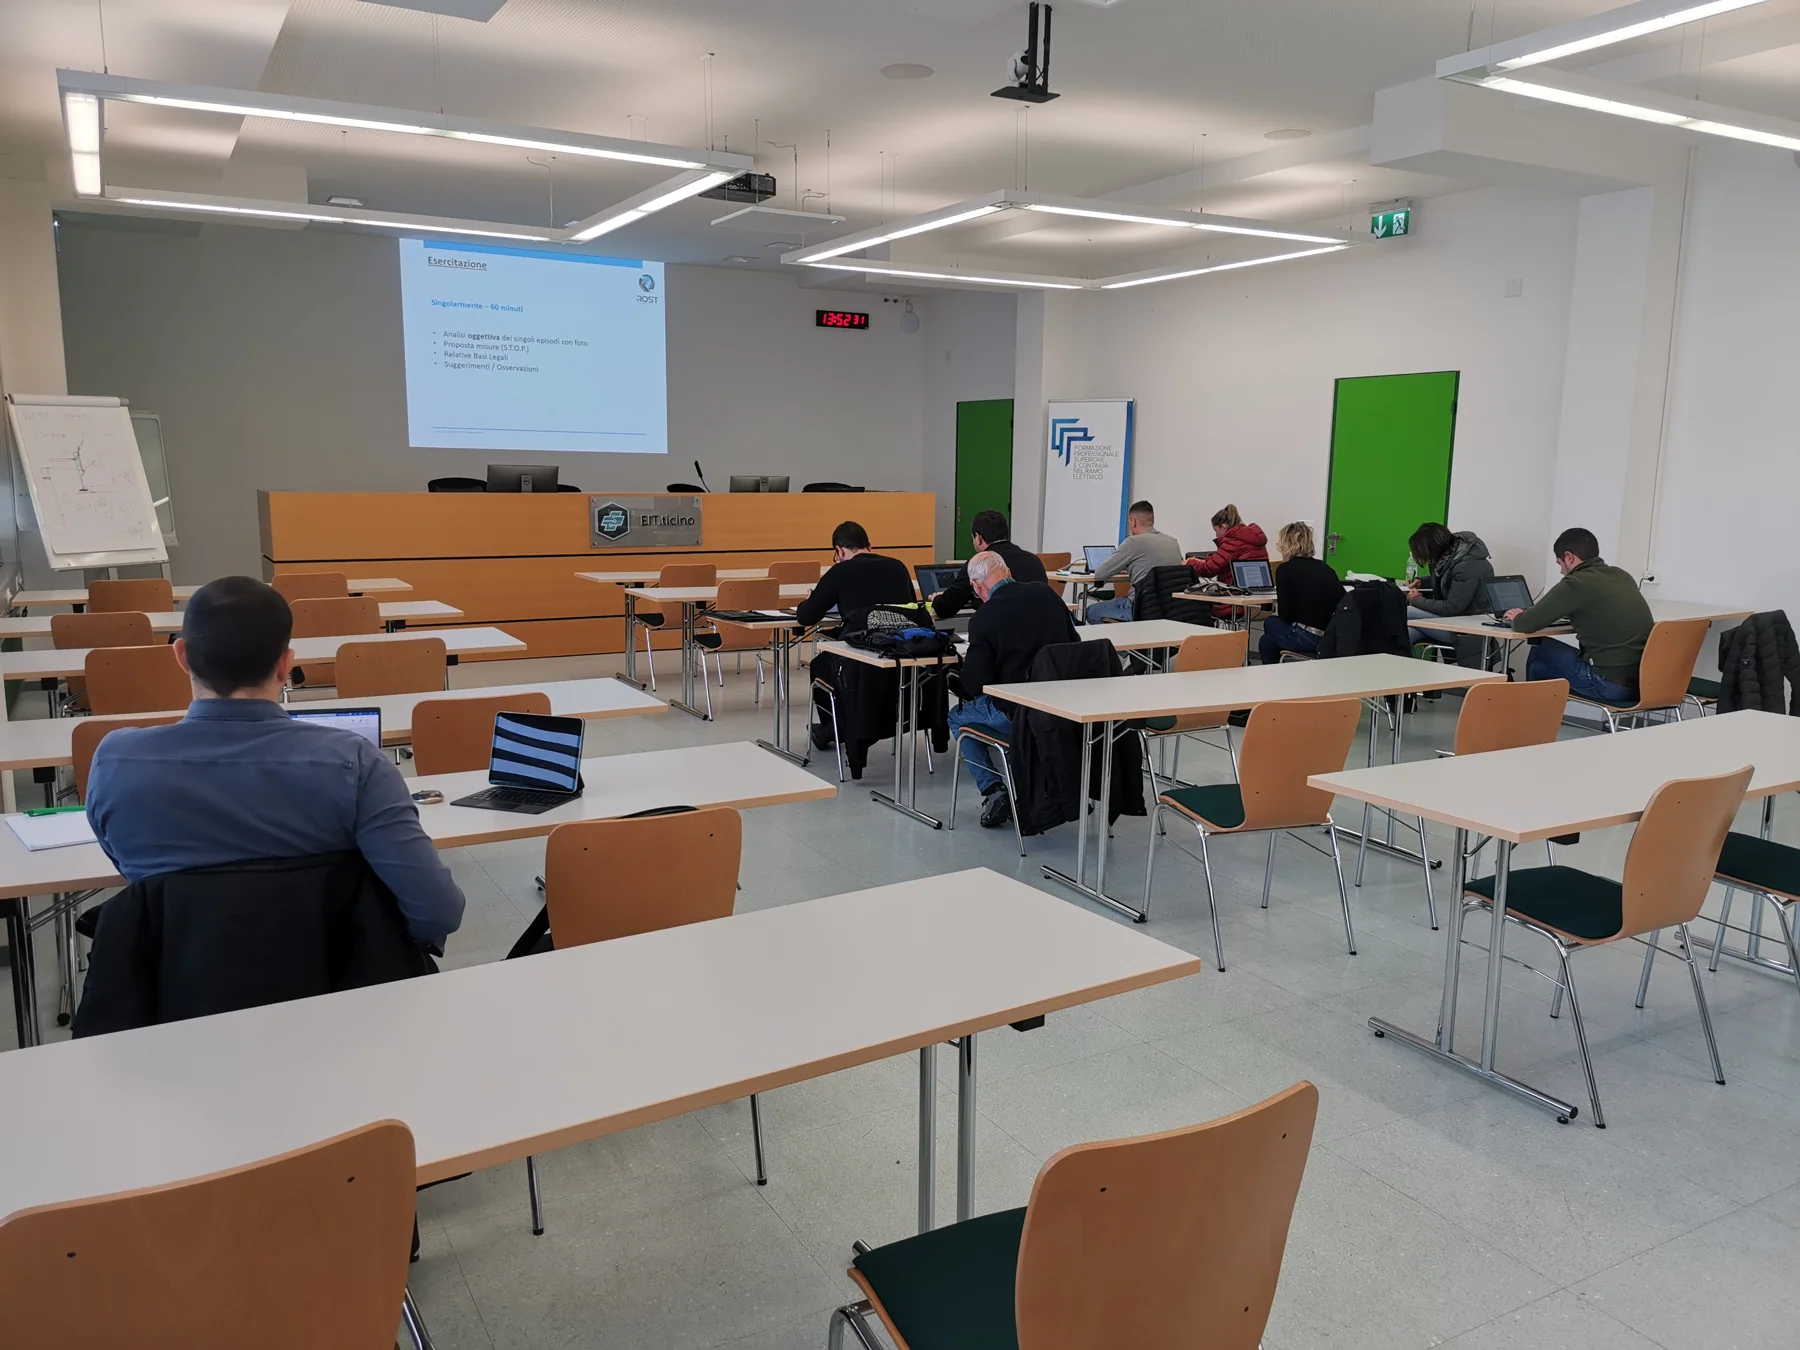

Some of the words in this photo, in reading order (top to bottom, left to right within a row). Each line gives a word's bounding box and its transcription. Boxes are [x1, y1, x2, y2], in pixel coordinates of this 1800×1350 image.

[428, 256, 487, 270] Esercitazione
[431, 299, 482, 309] Singolarmente
[500, 304, 524, 313] minuti
[636, 295, 658, 303] ROST
[822, 312, 851, 327] 13:52
[853, 314, 865, 325] 31
[443, 340, 475, 349] Proposta
[475, 342, 500, 351] misure
[501, 344, 530, 354] (S.T.O.P.)
[467, 333, 500, 341] oggettiva
[513, 335, 536, 344] singoli
[536, 337, 560, 345] episodi
[574, 339, 588, 347] foto
[444, 350, 472, 359] Relative
[473, 352, 487, 360] Basi
[488, 353, 509, 362] Legali
[444, 360, 490, 370] Suggerimenti
[496, 364, 539, 373] Osservazioni
[641, 515, 695, 526] EIT.ticino
